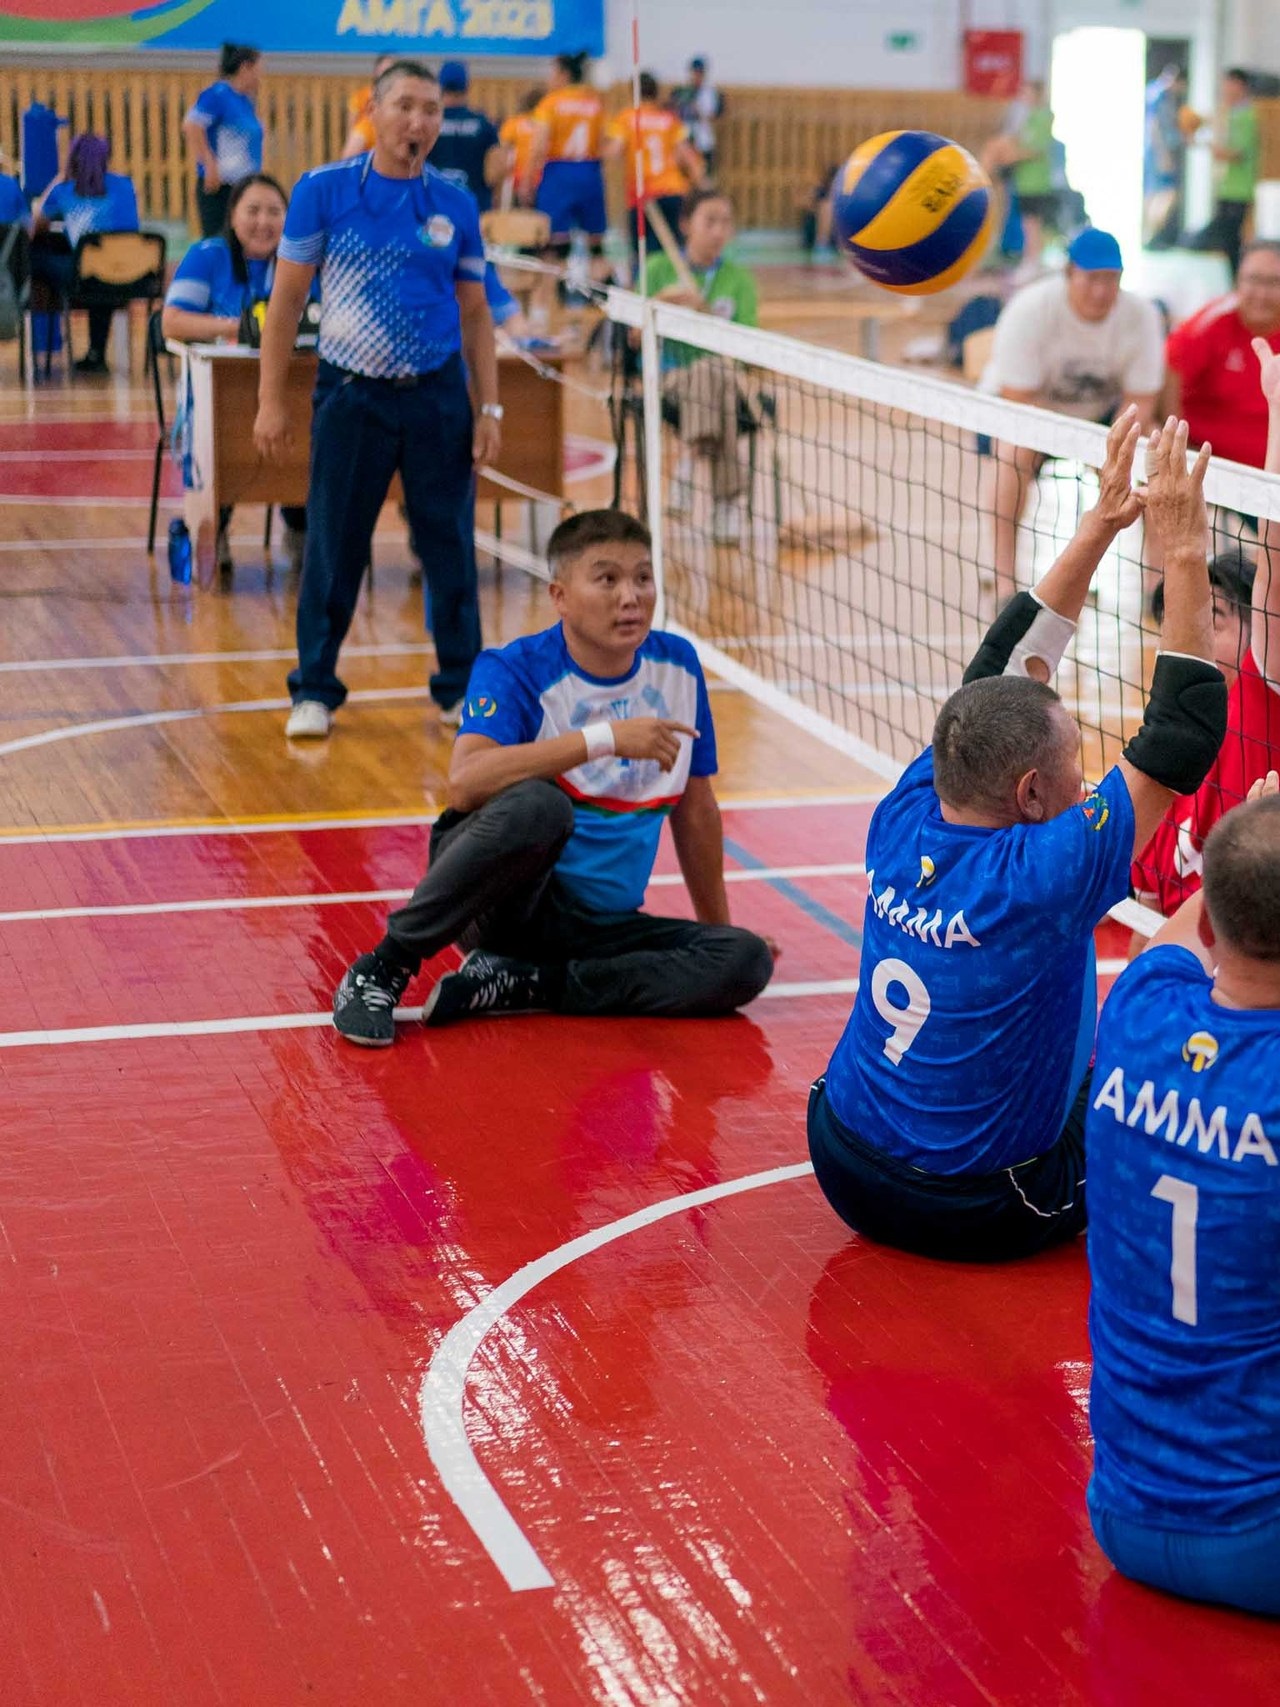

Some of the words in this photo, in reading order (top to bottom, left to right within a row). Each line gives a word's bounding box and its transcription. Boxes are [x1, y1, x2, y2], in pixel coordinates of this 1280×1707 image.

[460, 0, 555, 40] 2023
[562, 120, 592, 161] 4
[646, 134, 665, 175] 1
[871, 957, 931, 1067] 9
[1093, 1066, 1279, 1166] АММА
[1151, 1174, 1198, 1327] 1
